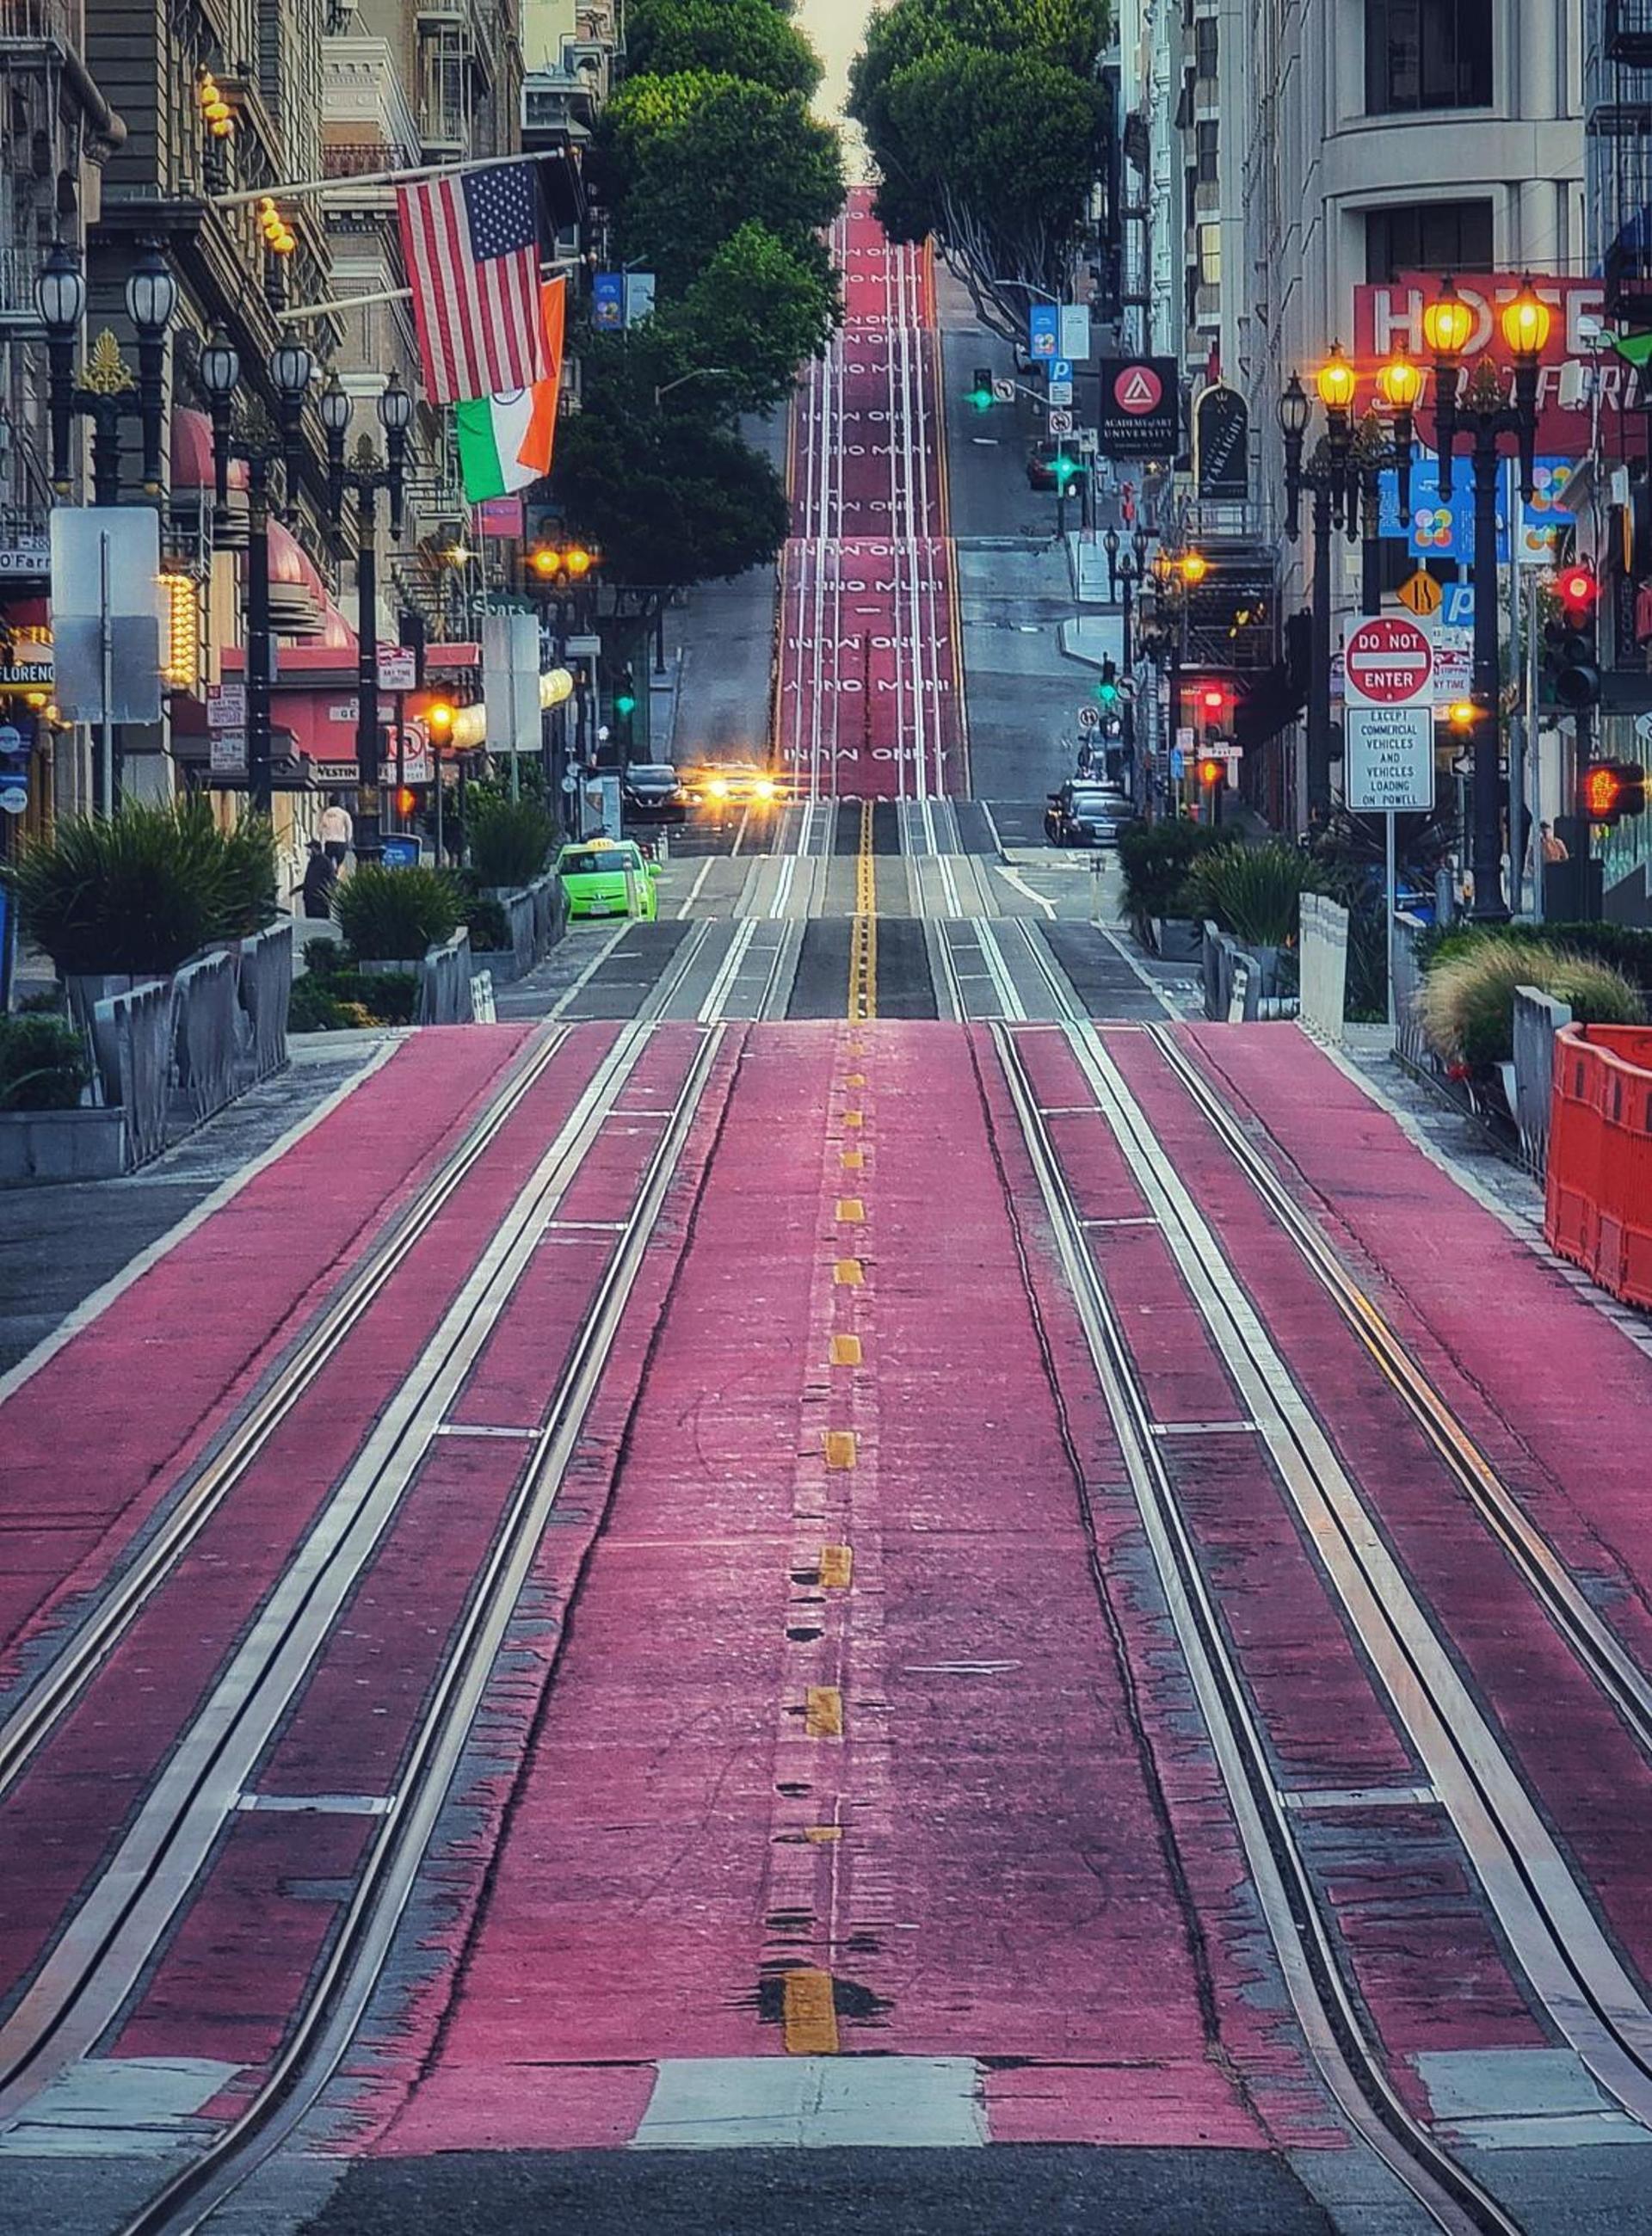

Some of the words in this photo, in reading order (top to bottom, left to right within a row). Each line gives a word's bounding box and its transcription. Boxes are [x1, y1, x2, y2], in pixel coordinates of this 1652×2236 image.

[1375, 289, 1630, 355] HOE
[1105, 418, 1147, 428] ACADEMY
[1156, 418, 1172, 427] ART
[1104, 429, 1172, 438] UNIVERSITY
[1203, 414, 1244, 492] STARLIGHT
[1359, 634, 1380, 650] DO
[1390, 633, 1419, 649] NOT
[1365, 672, 1414, 687] ENTER
[1371, 710, 1407, 722] EXCEPT
[1361, 724, 1418, 736] COMMERCIAL
[1366, 738, 1414, 749] VEHICLES
[1380, 753, 1401, 763] AND
[1366, 766, 1415, 778] VEHICLES
[1371, 780, 1410, 792] LOADING
[1362, 794, 1375, 805] ON
[1383, 794, 1417, 805] POWELL
